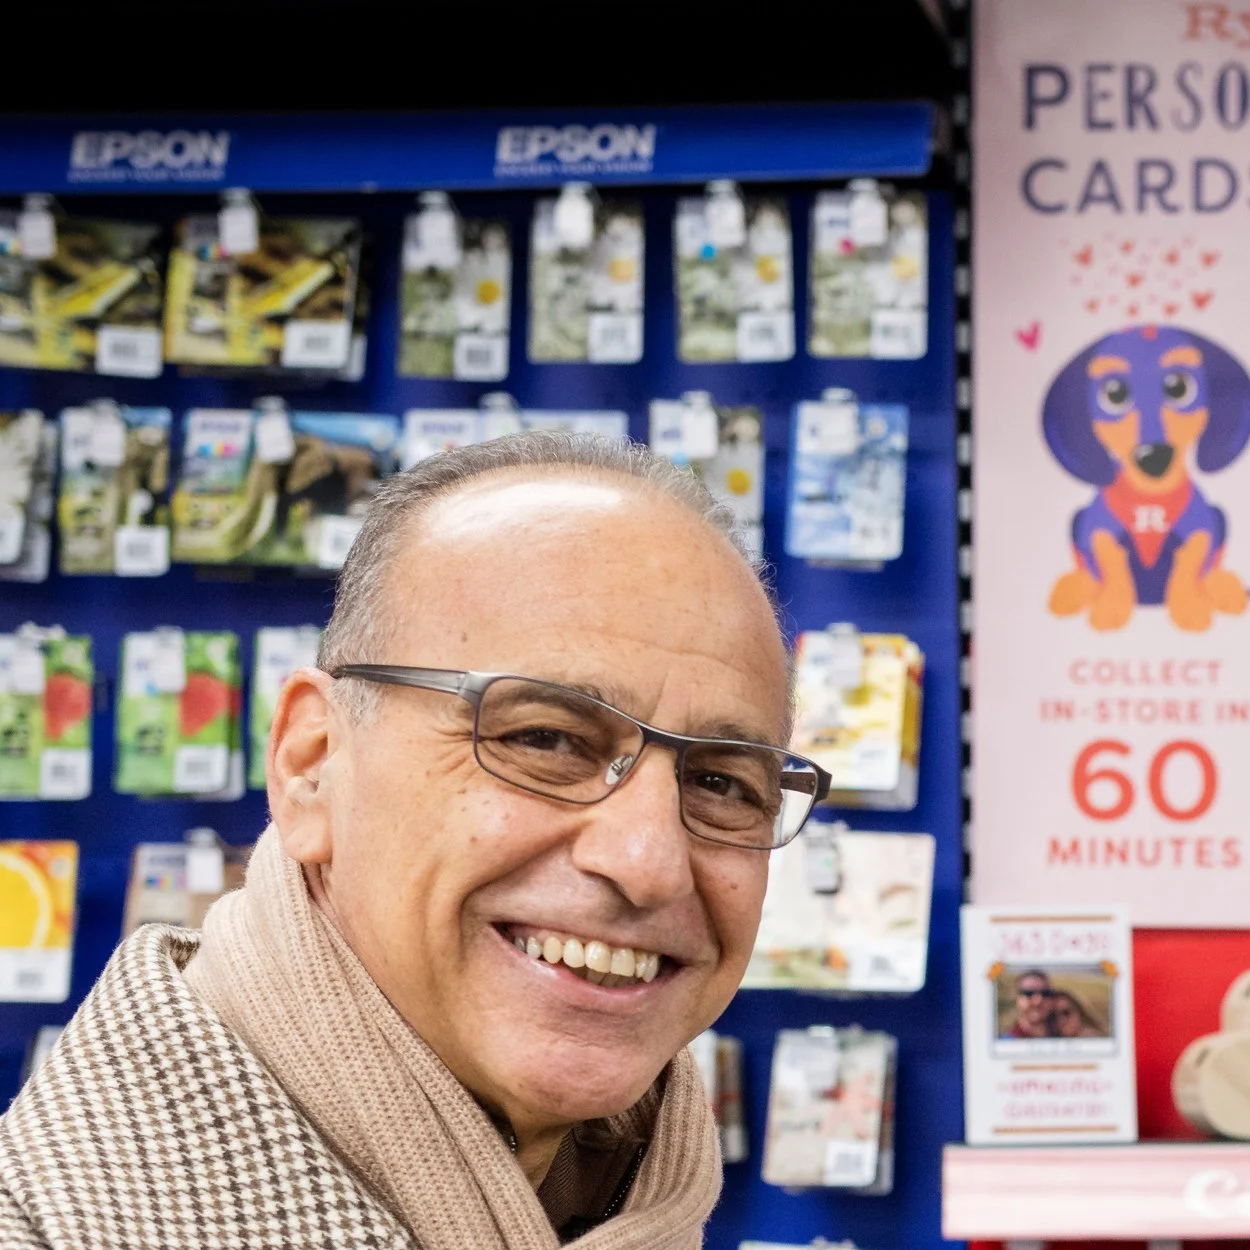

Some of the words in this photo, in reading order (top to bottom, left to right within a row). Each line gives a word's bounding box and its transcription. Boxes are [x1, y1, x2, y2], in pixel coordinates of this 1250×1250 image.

[71, 131, 230, 169] EPSON
[496, 125, 657, 163] EPSON
[1134, 503, 1167, 534] R
[1069, 659, 1222, 687] COLLECT
[1040, 698, 1202, 725] IN-STORE
[1070, 739, 1219, 823] 60
[1046, 837, 1243, 869] MINUTES
